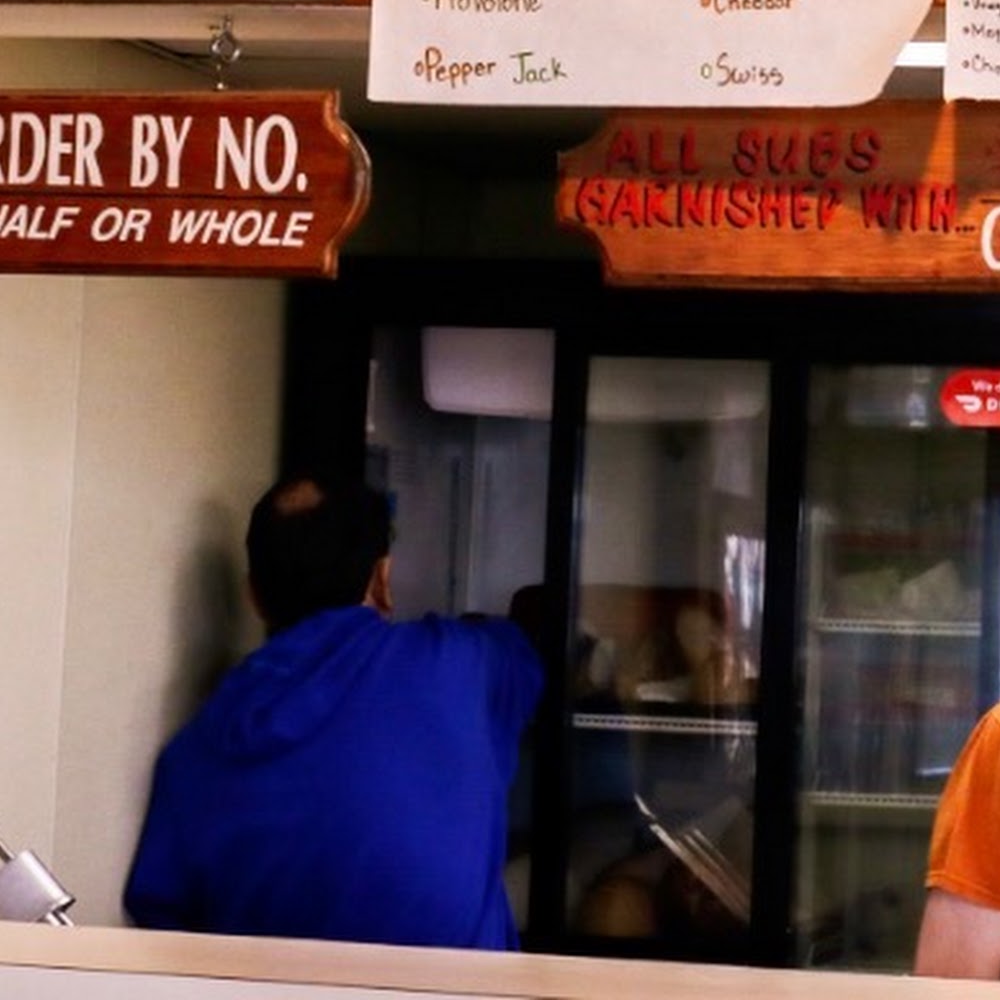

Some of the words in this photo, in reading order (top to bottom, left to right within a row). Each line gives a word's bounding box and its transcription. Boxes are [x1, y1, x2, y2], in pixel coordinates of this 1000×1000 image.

[424, 46, 497, 86] Pepper
[510, 52, 567, 86] Jack
[717, 52, 785, 87] Swiss
[129, 114, 193, 188] BY
[215, 114, 308, 195] NO.
[605, 125, 700, 176] ALL
[731, 125, 881, 178] SUBS
[91, 208, 152, 242] OR
[168, 209, 314, 248] WHOLE
